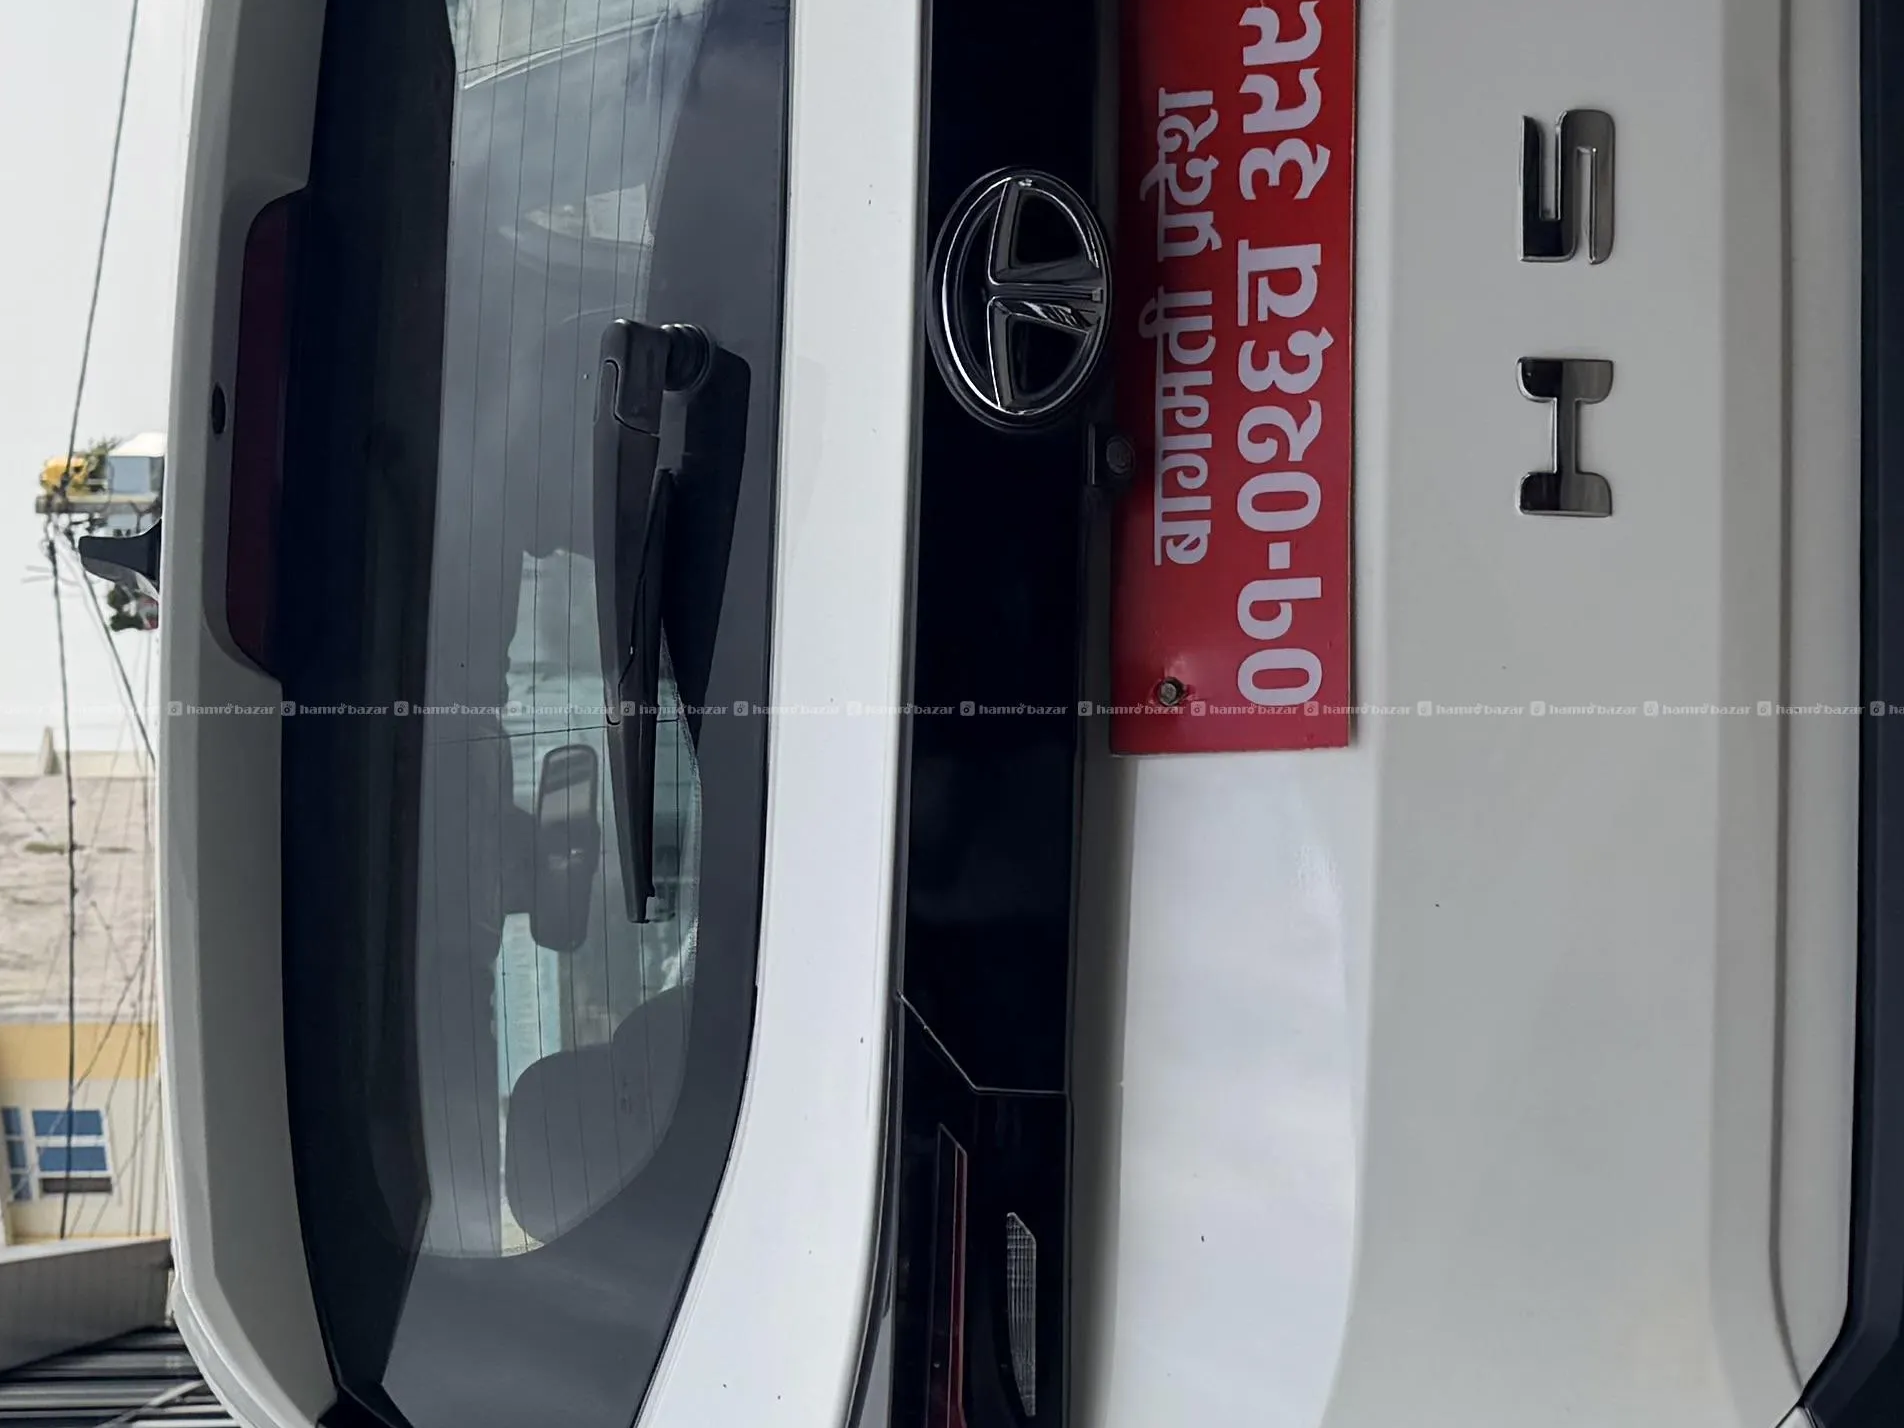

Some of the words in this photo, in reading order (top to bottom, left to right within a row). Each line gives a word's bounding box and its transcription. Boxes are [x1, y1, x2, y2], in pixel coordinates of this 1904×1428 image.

[1138, 87, 1221, 259] प्रदेश
[1138, 288, 1217, 566] बागमती
[1236, 239, 1333, 708] ०१-०२६च
